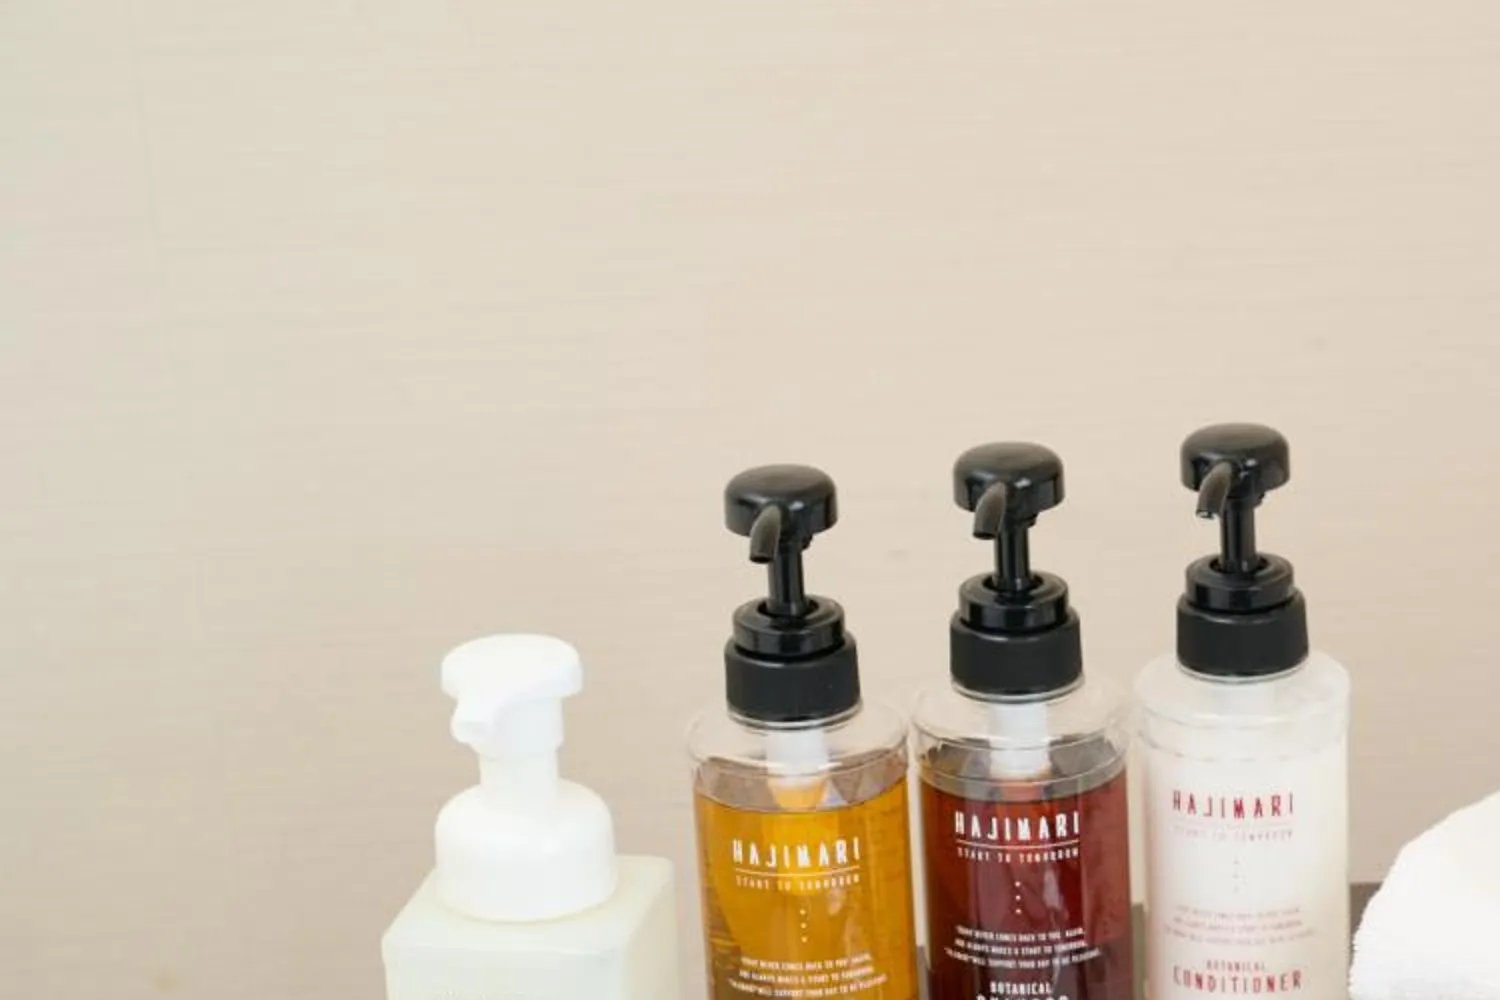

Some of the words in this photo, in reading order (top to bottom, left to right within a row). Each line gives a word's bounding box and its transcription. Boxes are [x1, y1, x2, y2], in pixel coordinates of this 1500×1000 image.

[1173, 789, 1294, 819] HAJIMARI
[955, 811, 1079, 841] HAJIMARI
[732, 837, 860, 868] HAJIMARI
[990, 981, 1051, 995] BOTANICAL
[1173, 965, 1302, 994] CONDITIONER
